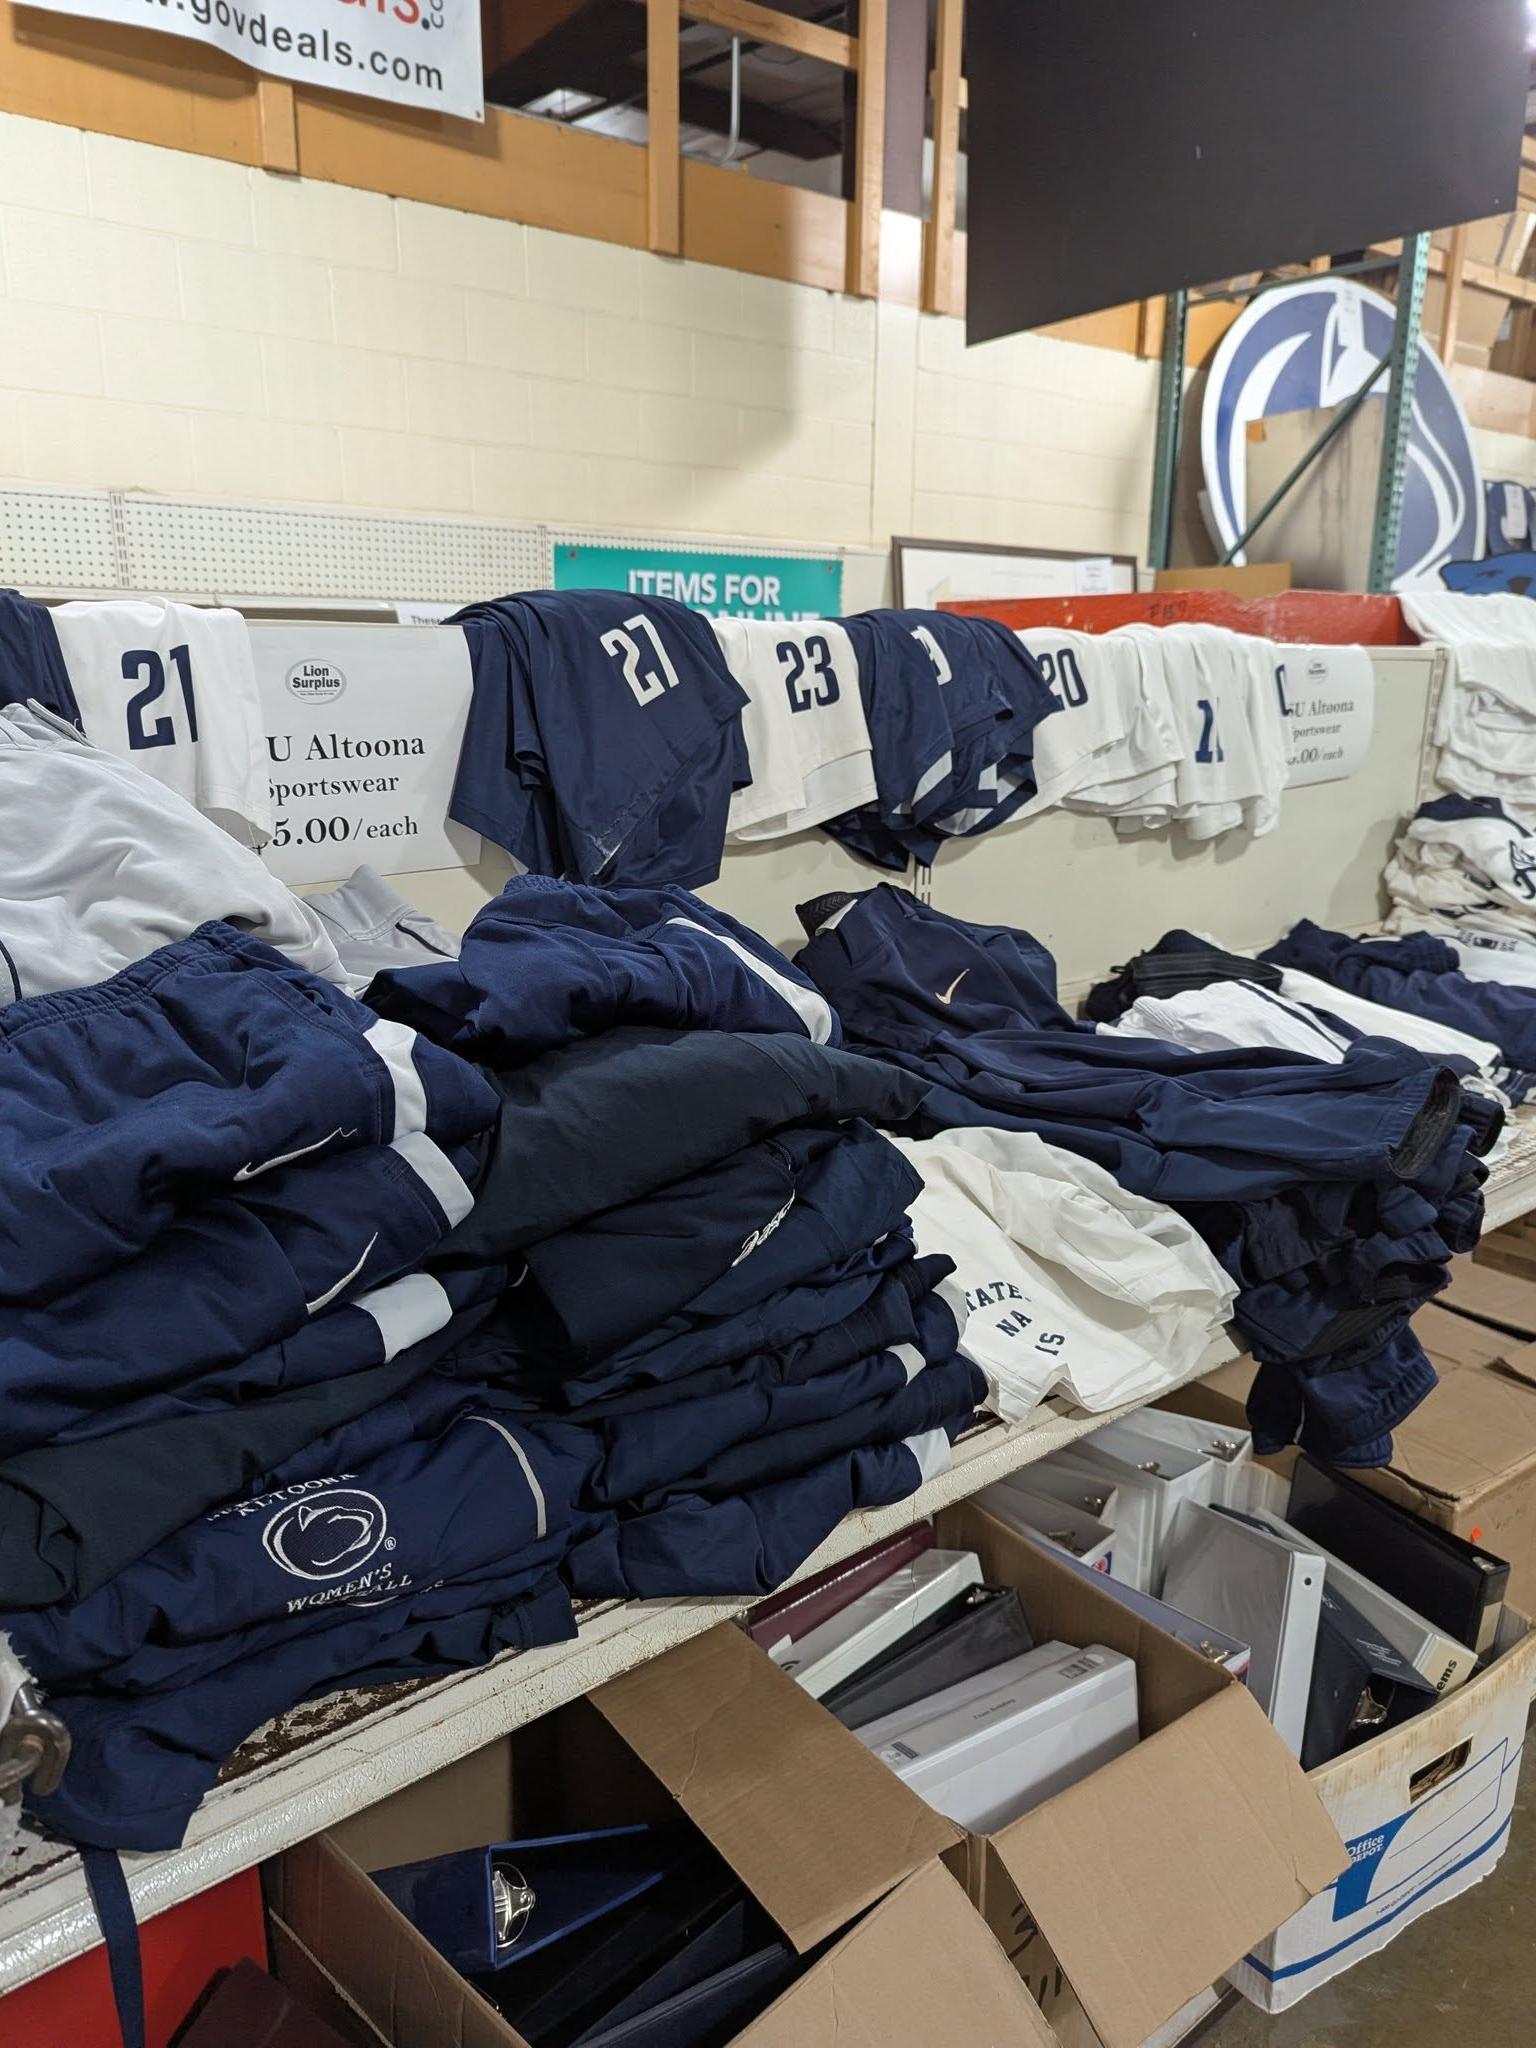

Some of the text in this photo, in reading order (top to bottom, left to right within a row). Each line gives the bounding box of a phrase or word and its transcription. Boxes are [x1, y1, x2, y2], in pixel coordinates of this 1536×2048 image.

[143, 0, 444, 91] .govdeals.com
[628, 570, 781, 606] ITEMS FOR
[303, 665, 330, 677] Lion
[600, 614, 680, 706] 27
[776, 635, 841, 714] 23
[121, 644, 199, 751] 21
[292, 676, 341, 690] Surplus
[305, 733, 426, 761] Altoona
[1292, 724, 1342, 743] portswear
[252, 815, 419, 855] 5.00/each
[995, 1310, 1033, 1338] NA
[286, 1562, 393, 1613] WOMEN'S
[1347, 1835, 1385, 1857] Office
